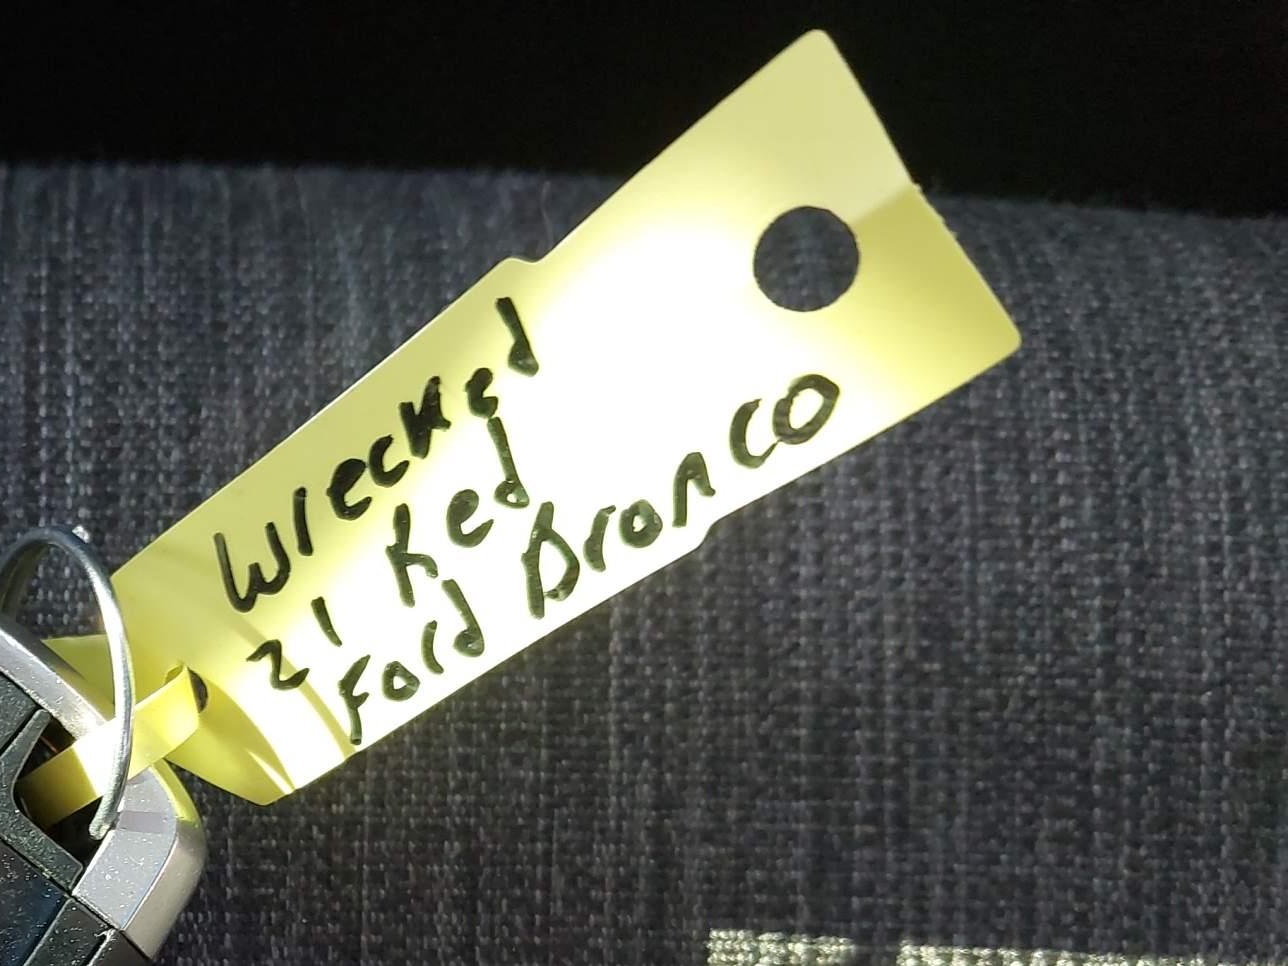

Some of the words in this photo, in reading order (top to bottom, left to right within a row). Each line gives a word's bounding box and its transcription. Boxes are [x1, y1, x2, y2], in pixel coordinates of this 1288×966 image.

[213, 296, 540, 614] Wrecked
[247, 595, 342, 691] 21
[387, 417, 530, 607] Red
[338, 579, 486, 746] Ford
